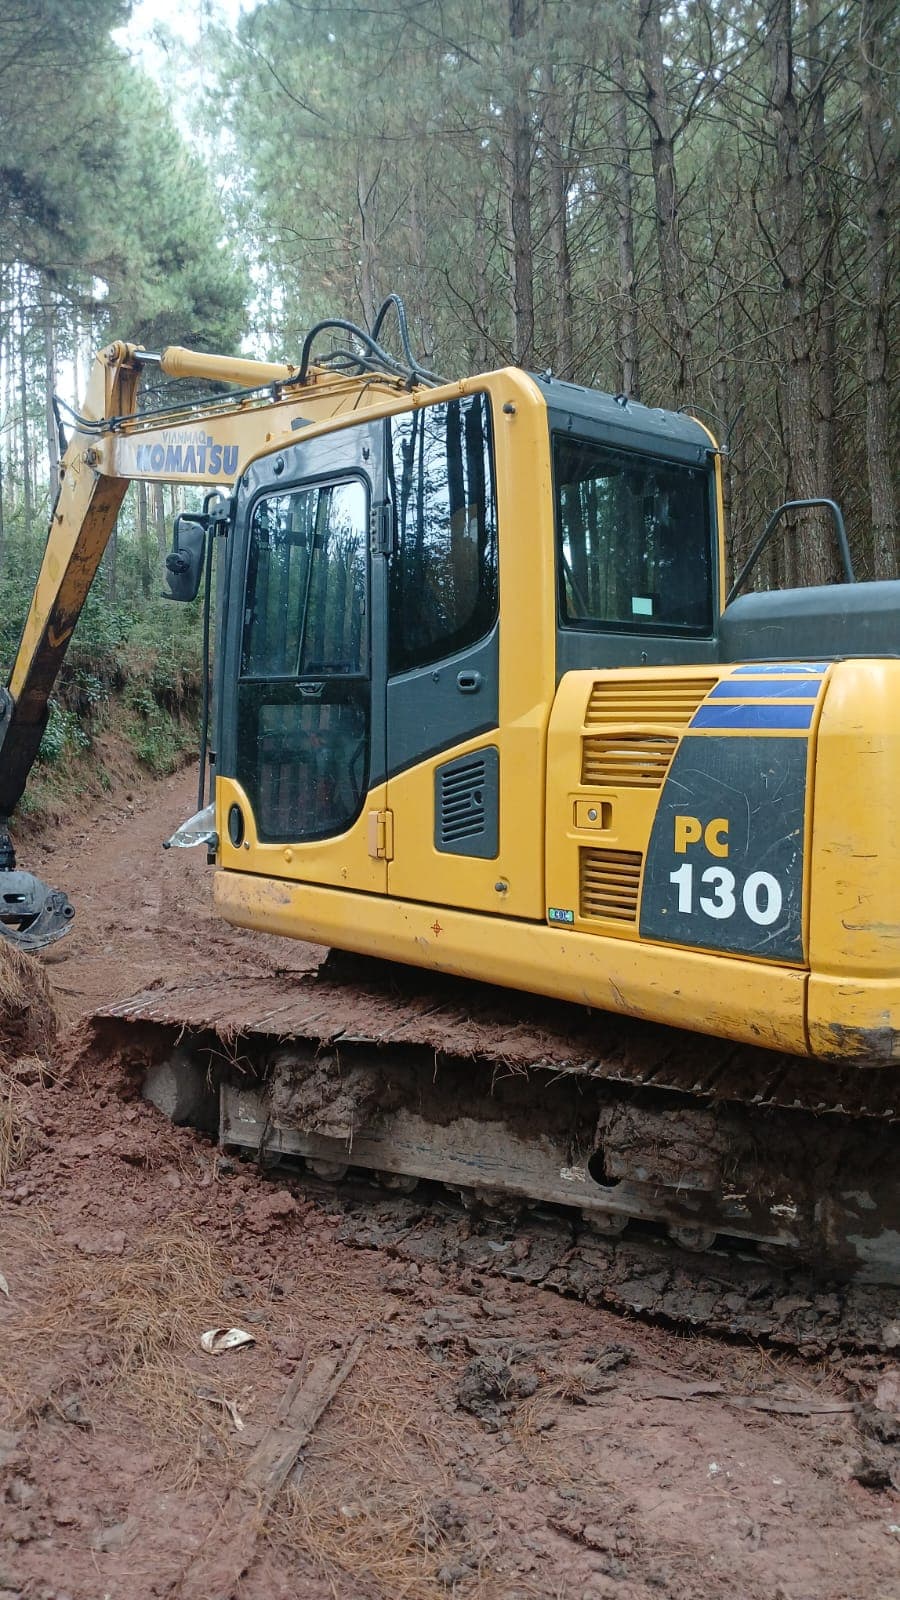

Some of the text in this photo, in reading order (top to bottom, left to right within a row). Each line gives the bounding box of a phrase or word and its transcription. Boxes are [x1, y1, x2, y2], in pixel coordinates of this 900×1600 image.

[136, 436, 240, 475] KOMATSU
[674, 815, 729, 858] PC
[669, 863, 783, 926] 130
